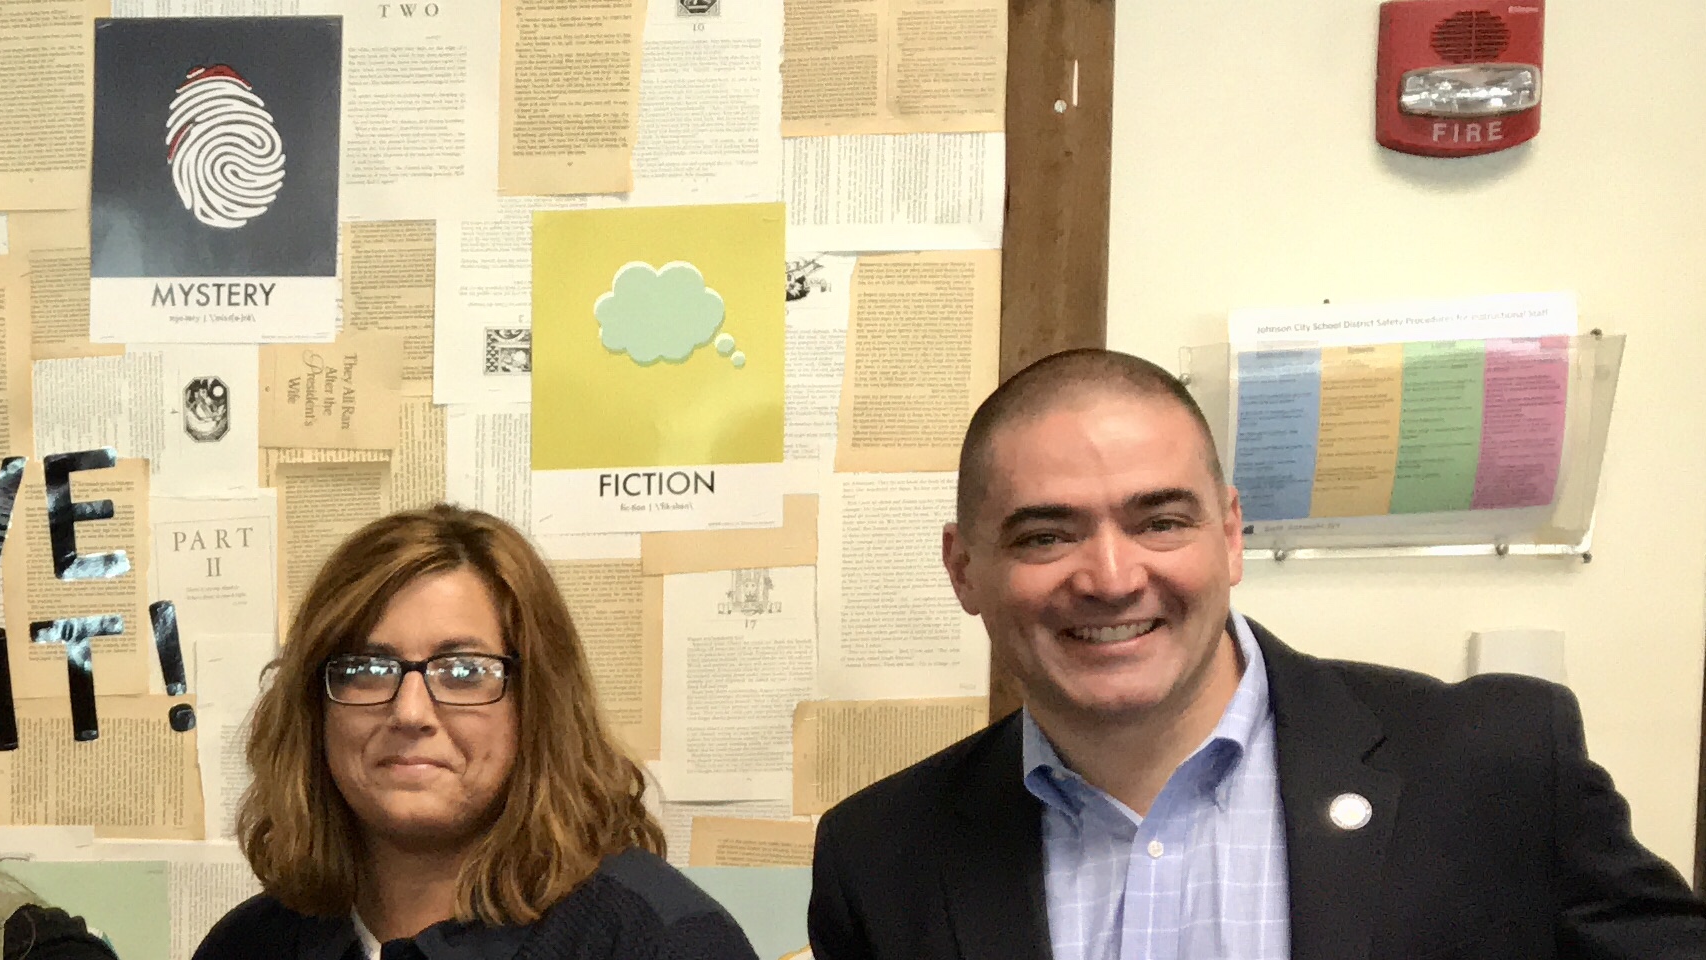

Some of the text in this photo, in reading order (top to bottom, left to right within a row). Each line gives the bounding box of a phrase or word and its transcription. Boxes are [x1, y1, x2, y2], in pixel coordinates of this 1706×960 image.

[377, 3, 440, 19] TWO
[1432, 120, 1503, 143] FIRE
[151, 282, 277, 307] MYSTERY
[1312, 321, 1342, 331] School
[1343, 319, 1374, 329] District
[301, 349, 325, 427] President's
[323, 366, 338, 416] After the
[341, 352, 358, 430] They All Ran
[599, 471, 715, 498] FICTION
[172, 526, 254, 552] PART
[206, 556, 222, 578] II
